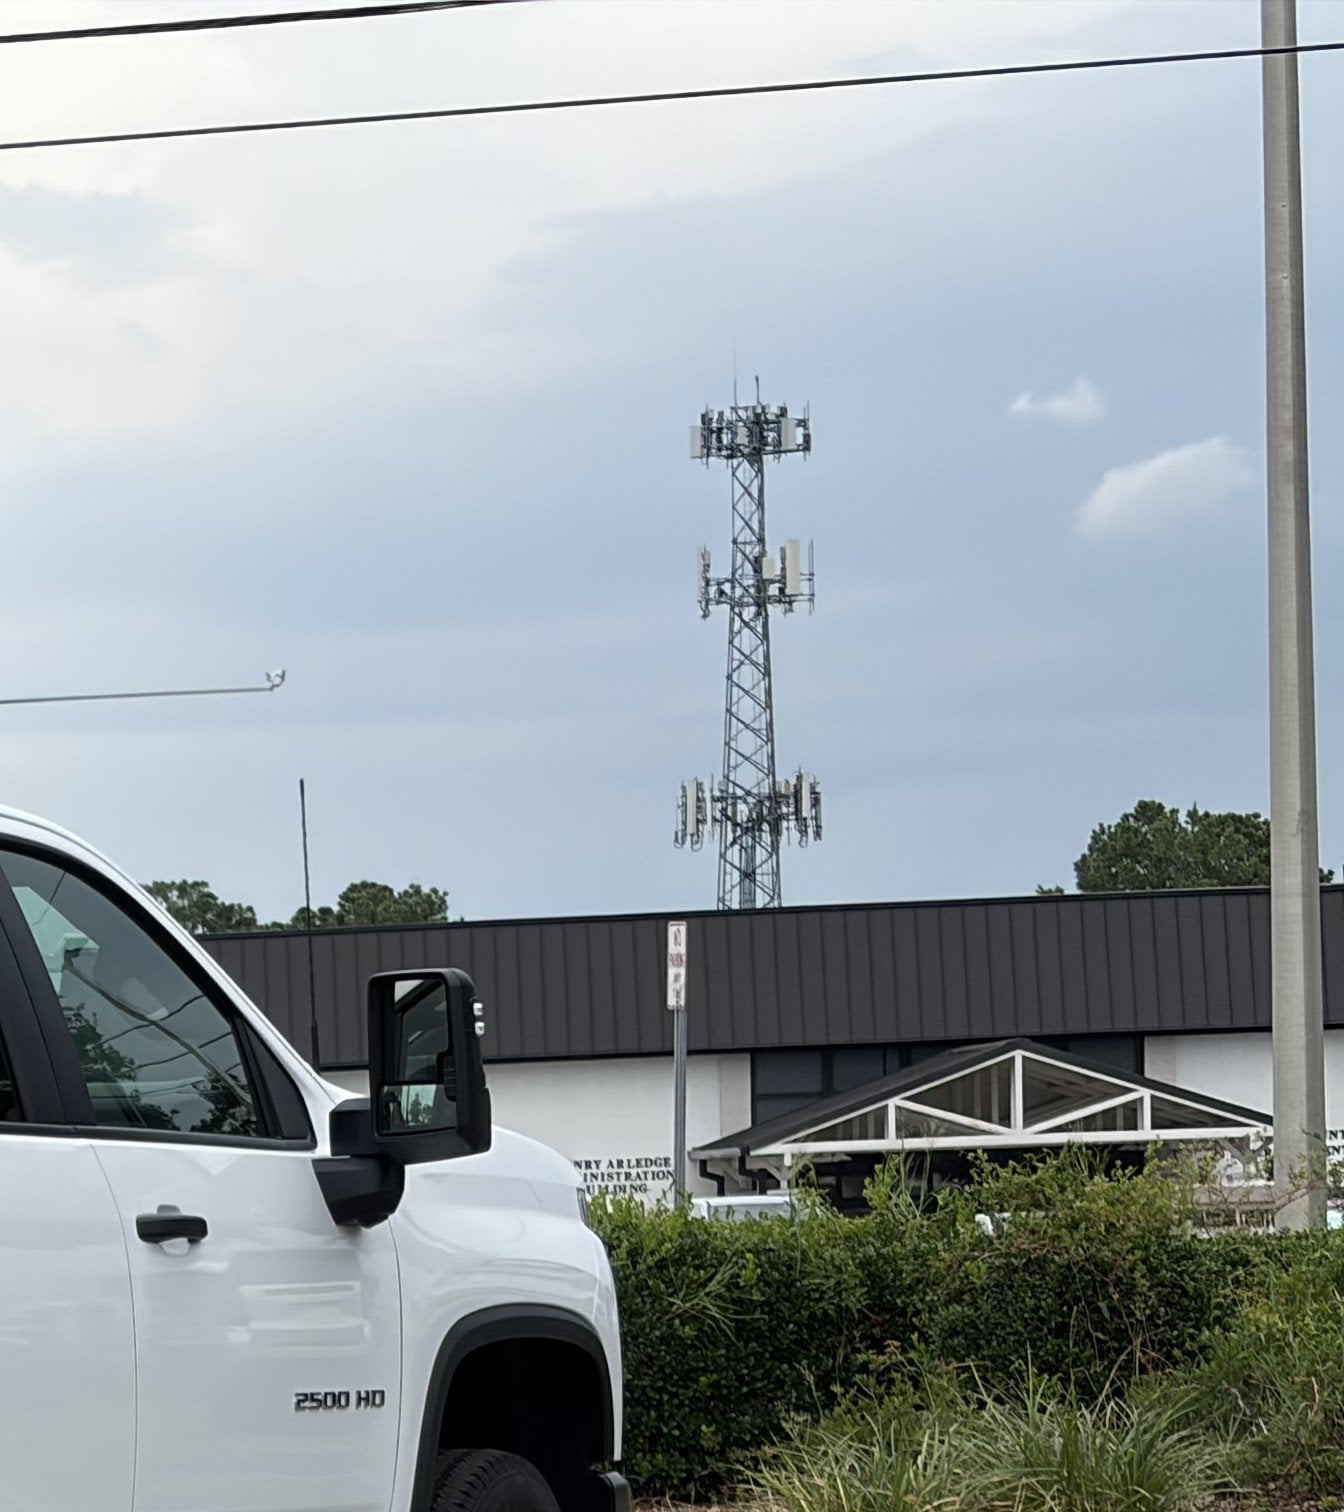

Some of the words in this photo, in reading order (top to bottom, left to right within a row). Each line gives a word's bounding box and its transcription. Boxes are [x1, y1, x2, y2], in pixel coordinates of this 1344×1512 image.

[573, 1159, 602, 1170] NRY
[607, 1156, 672, 1169] ARLEDGE
[583, 1169, 676, 1183] INISTRATION
[586, 1183, 648, 1195] UILDING
[294, 1390, 350, 1412] 2500
[355, 1389, 385, 1409] HD
